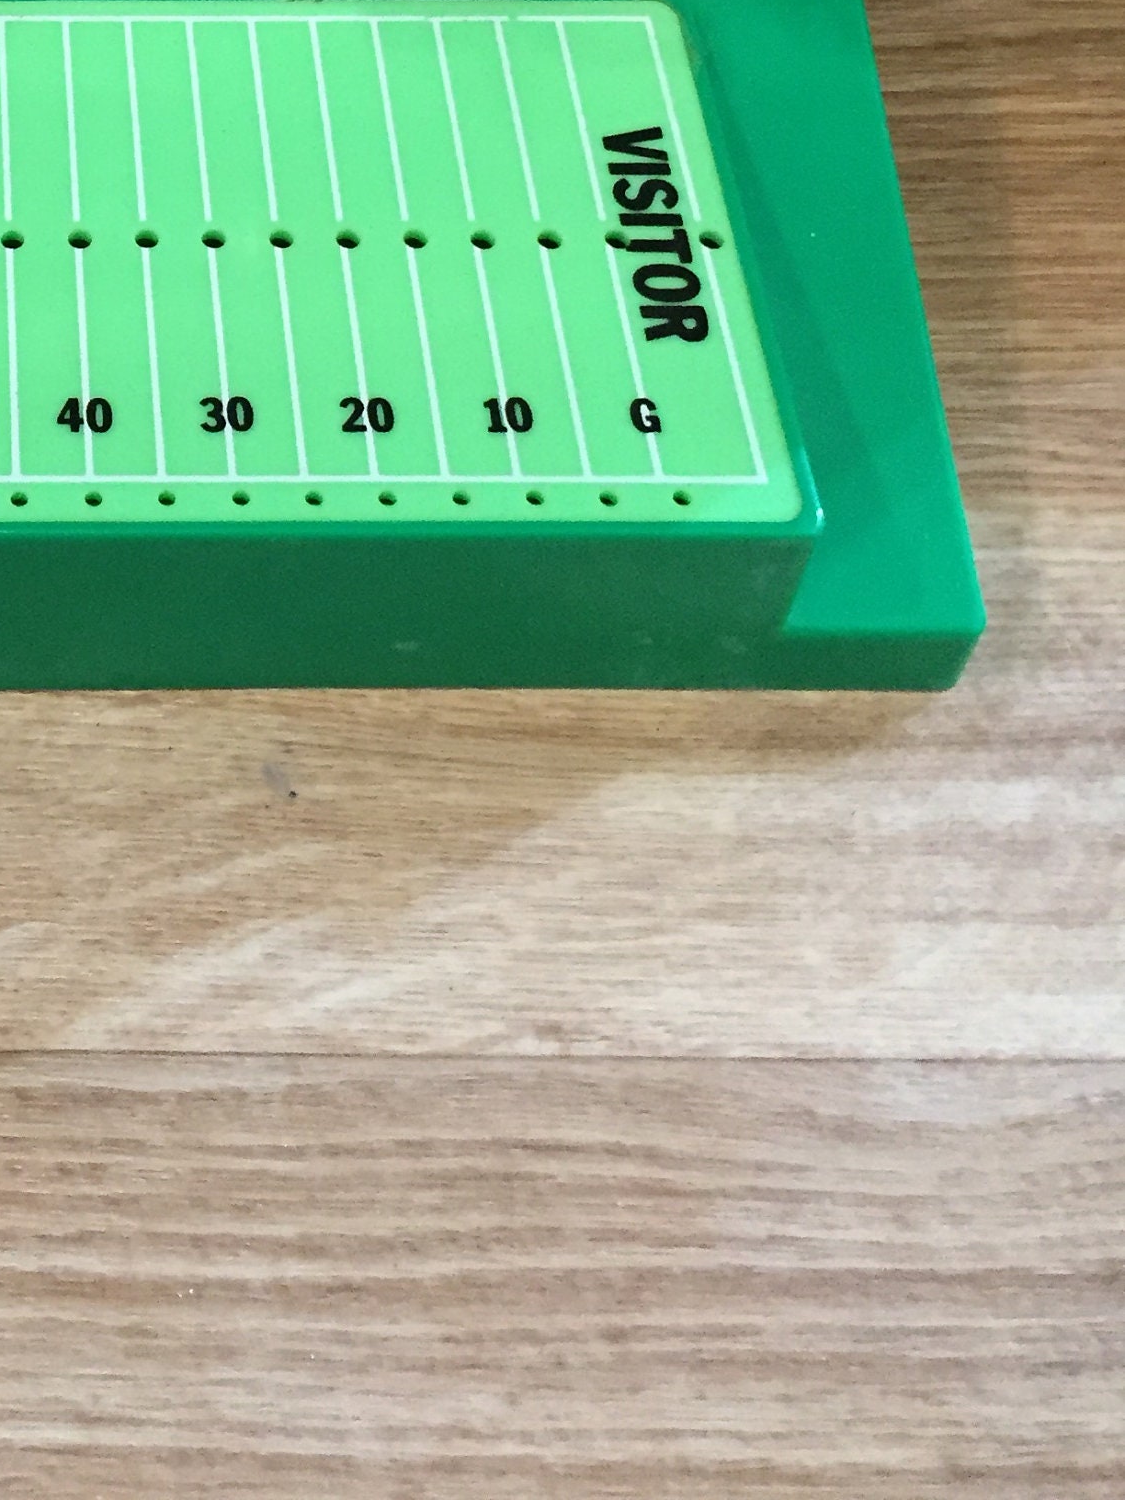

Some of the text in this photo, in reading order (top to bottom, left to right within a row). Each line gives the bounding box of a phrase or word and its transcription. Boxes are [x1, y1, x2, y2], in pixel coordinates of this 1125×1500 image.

[602, 127, 709, 343] VISITOR
[57, 397, 113, 434] 40
[200, 397, 254, 434] 30
[339, 397, 394, 434] 20
[485, 397, 534, 434] 10
[630, 398, 662, 434] G
